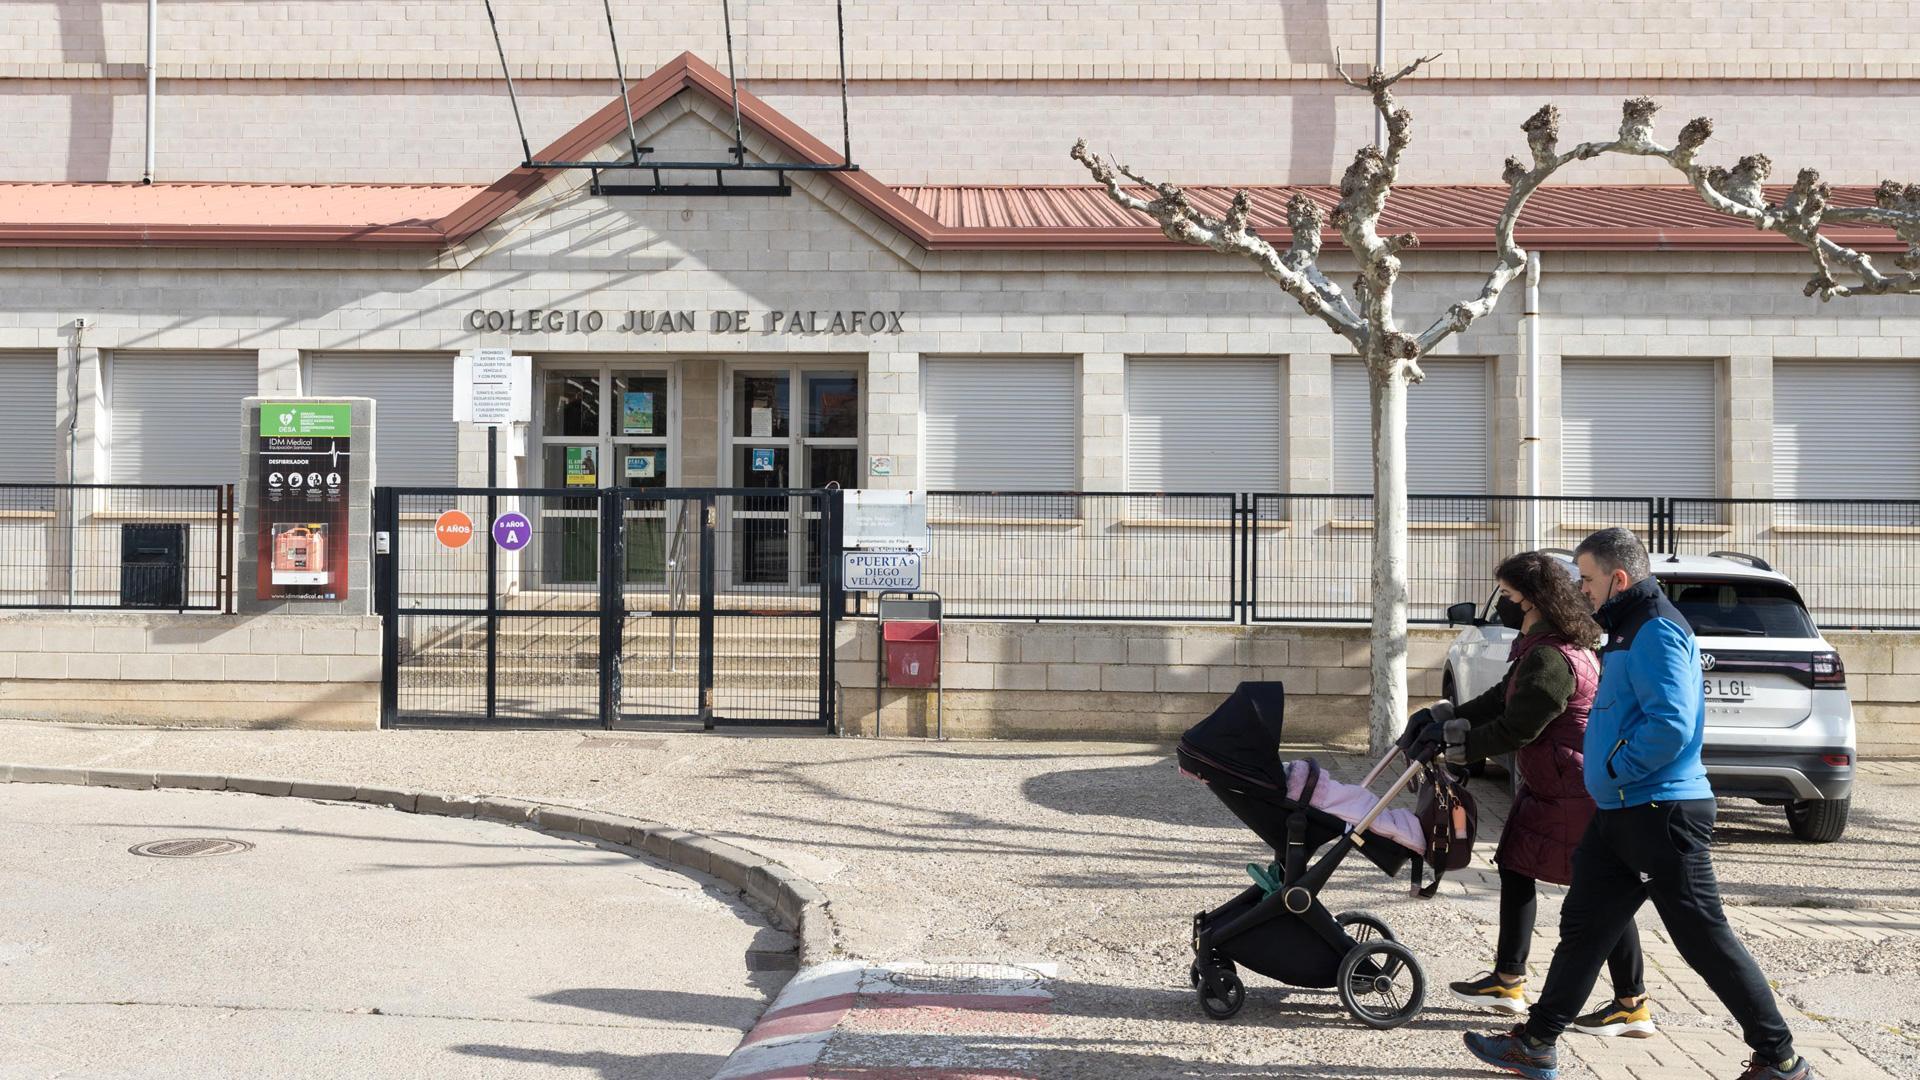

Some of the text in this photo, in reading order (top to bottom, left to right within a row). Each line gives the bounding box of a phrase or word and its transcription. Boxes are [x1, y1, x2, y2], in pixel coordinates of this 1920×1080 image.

[470, 309, 905, 333] COLEGIO JUAN DE PALAFOX
[269, 438, 313, 446] IDM Medical
[446, 524, 470, 534] AÑOS
[506, 520, 524, 528] AÑOS
[506, 530, 519, 544] A
[856, 556, 908, 567] PUERTA
[865, 567, 900, 577] DIEGO
[851, 576, 914, 587] VELÁZQUEZ
[1719, 680, 1751, 696] LGL
